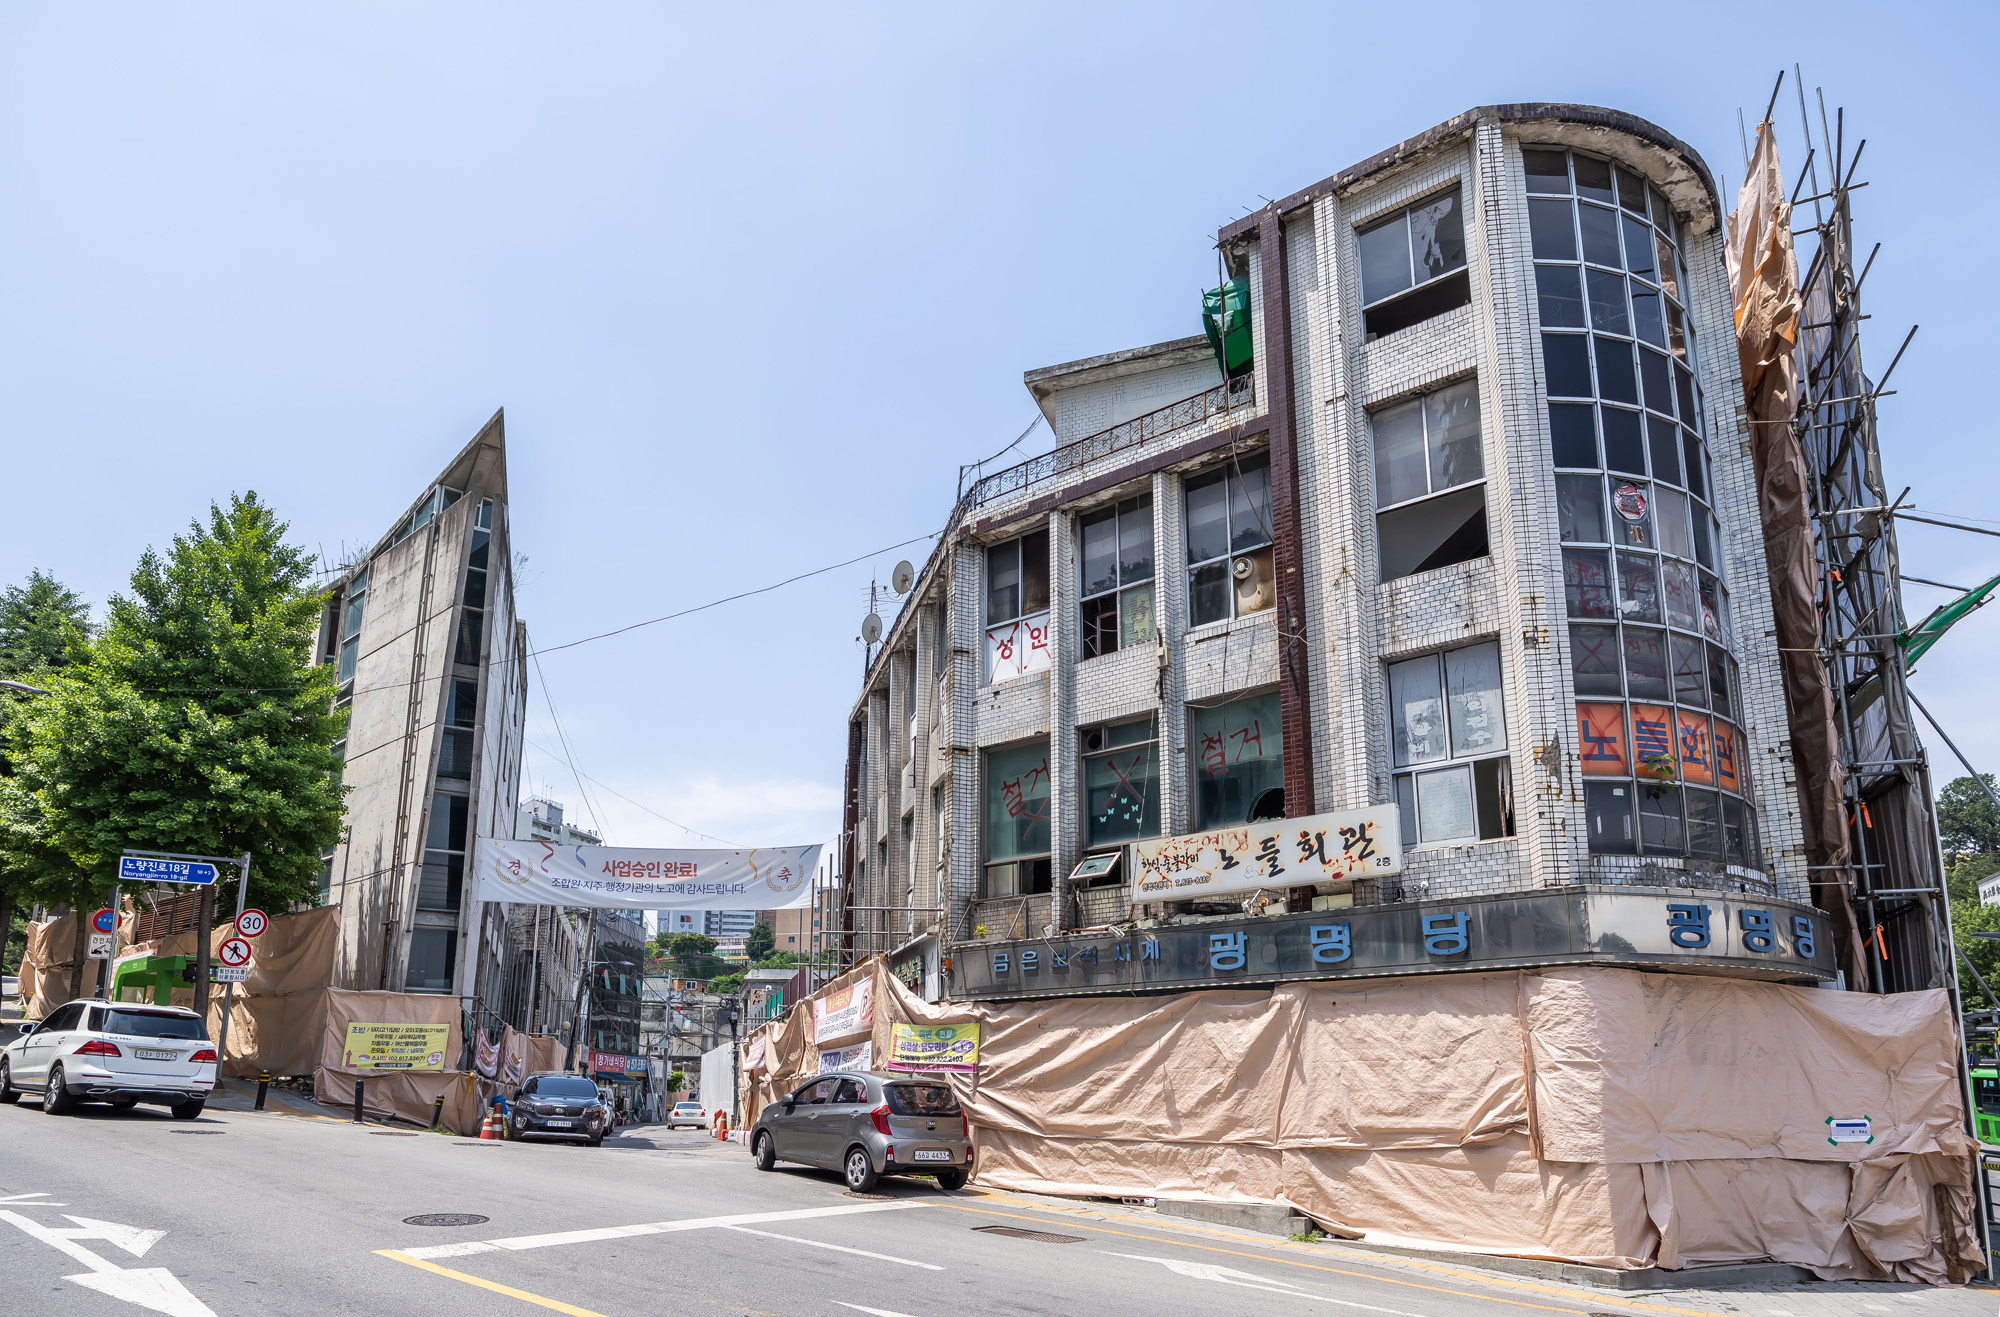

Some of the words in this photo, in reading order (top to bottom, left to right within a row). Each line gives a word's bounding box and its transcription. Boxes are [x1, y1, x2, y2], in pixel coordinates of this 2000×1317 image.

[996, 625, 1048, 660] 성인
[1200, 720, 1263, 780] 철거
[1581, 719, 1735, 780] 노들회관
[1000, 757, 1051, 818] 철거
[1219, 822, 1376, 878] 노들회관
[124, 860, 190, 875] 노량진로18길
[507, 859, 522, 876] 경
[777, 865, 793, 884] 축
[602, 860, 661, 878] 사업승인
[663, 862, 698, 878] 완료!
[1376, 856, 1391, 867] 2층
[123, 870, 168, 879] Noryangjin-ro
[551, 877, 654, 894] 조합원·지주·행정기관의
[655, 884, 685, 894] 노고에
[686, 882, 747, 895] 감사드립니다.
[242, 916, 262, 930] 30
[1666, 903, 1816, 959] 광명당
[92, 936, 118, 945] 견인지
[1209, 911, 1471, 971] 광명당
[351, 1026, 366, 1034] 초밥
